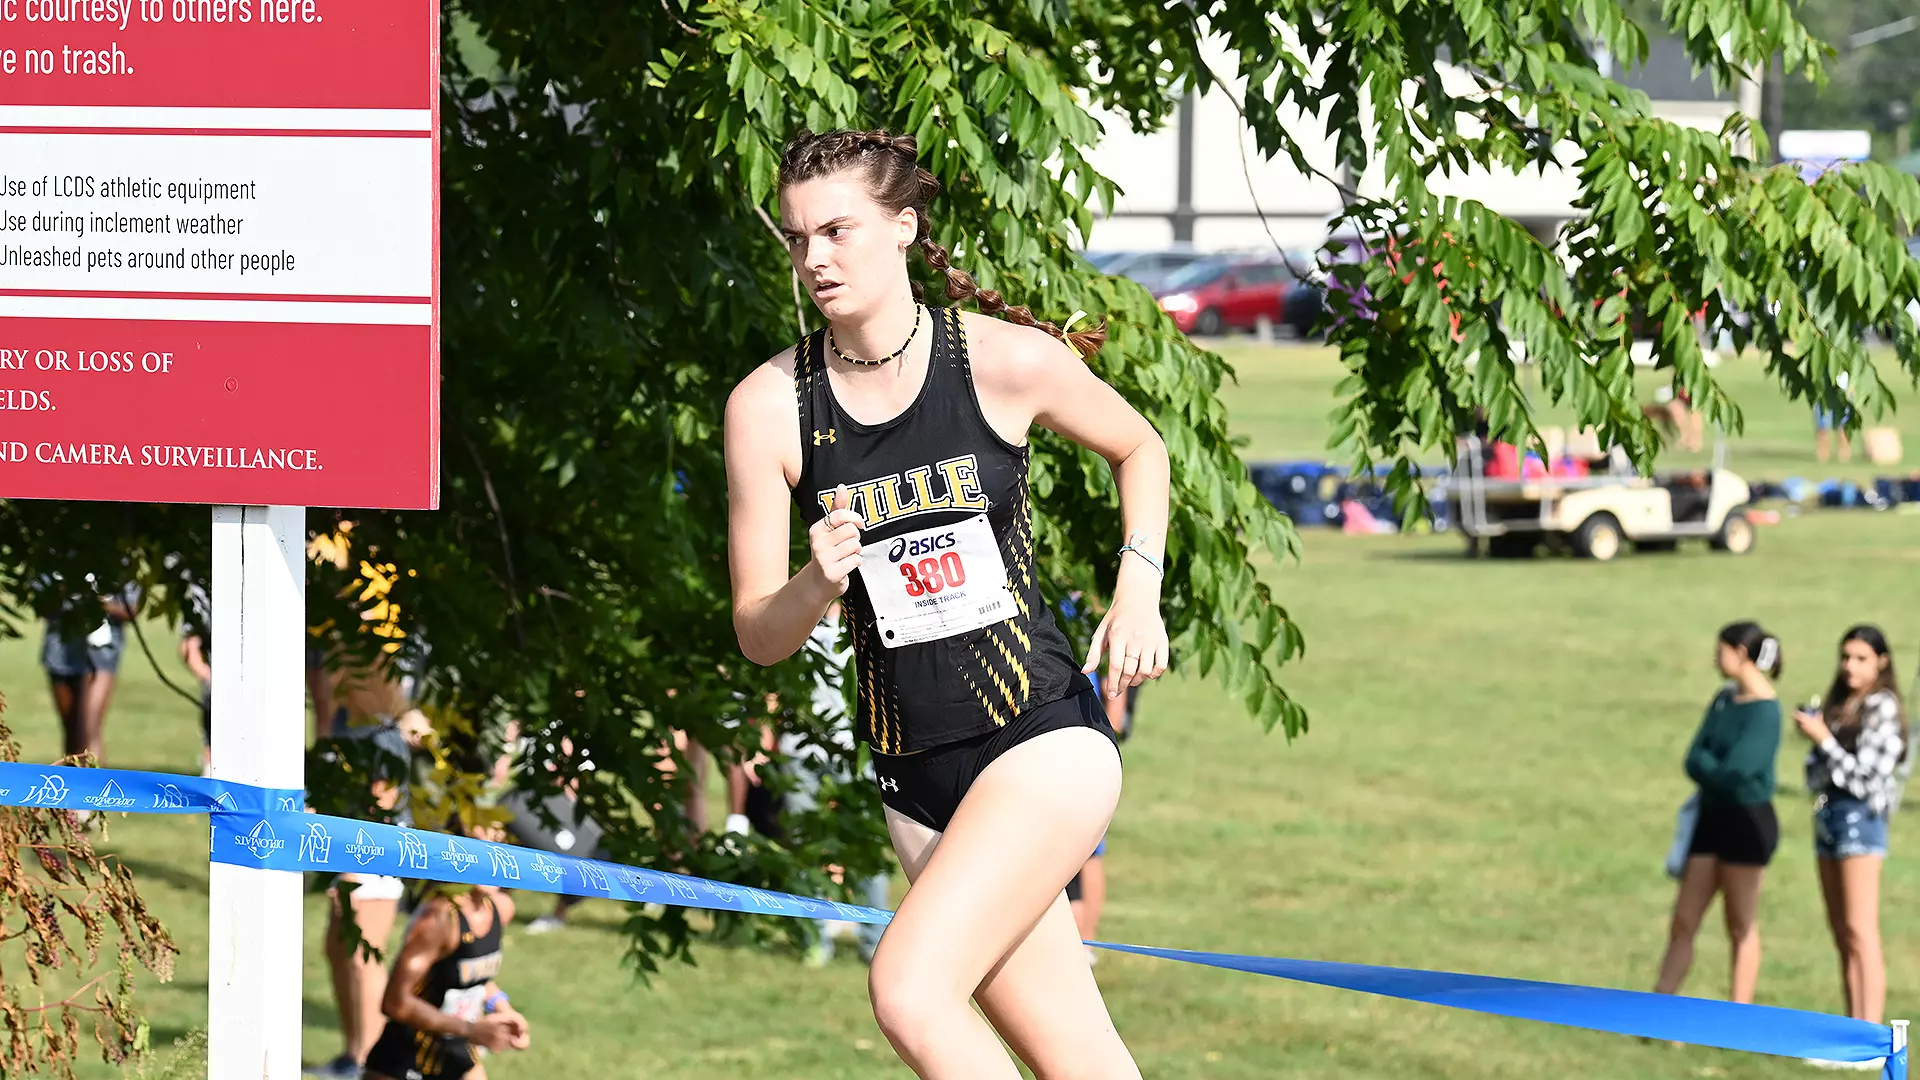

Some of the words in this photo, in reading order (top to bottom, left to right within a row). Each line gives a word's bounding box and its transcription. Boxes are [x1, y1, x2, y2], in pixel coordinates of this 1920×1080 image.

[26, 0, 131, 30] courtesy
[140, 0, 163, 22] to
[173, 0, 251, 22] others
[261, 0, 322, 23] here.
[0, 50, 16, 73] e
[26, 50, 53, 74] no
[62, 42, 133, 74] trash.
[33, 176, 47, 196] of
[55, 176, 94, 197] LCDS
[101, 177, 161, 198] athletic
[168, 178, 255, 204] equipment
[33, 211, 83, 237] during
[91, 212, 170, 233] inclement
[177, 213, 243, 234] weather
[88, 249, 122, 272] pets
[128, 248, 184, 268] around
[192, 248, 234, 269] other
[241, 250, 294, 275] people
[35, 350, 71, 370] OR
[78, 351, 133, 372] LOSS
[142, 352, 173, 372] OF
[36, 443, 134, 465] CAMERA
[141, 446, 322, 470] SURVEILLANCE.
[910, 531, 955, 555] asics
[900, 551, 967, 598] 380
[914, 597, 939, 609] INSIDE
[940, 590, 967, 604] TRACK
[234, 835, 285, 850] DIPLOMATS
[345, 843, 385, 857] DIPLOMATS
